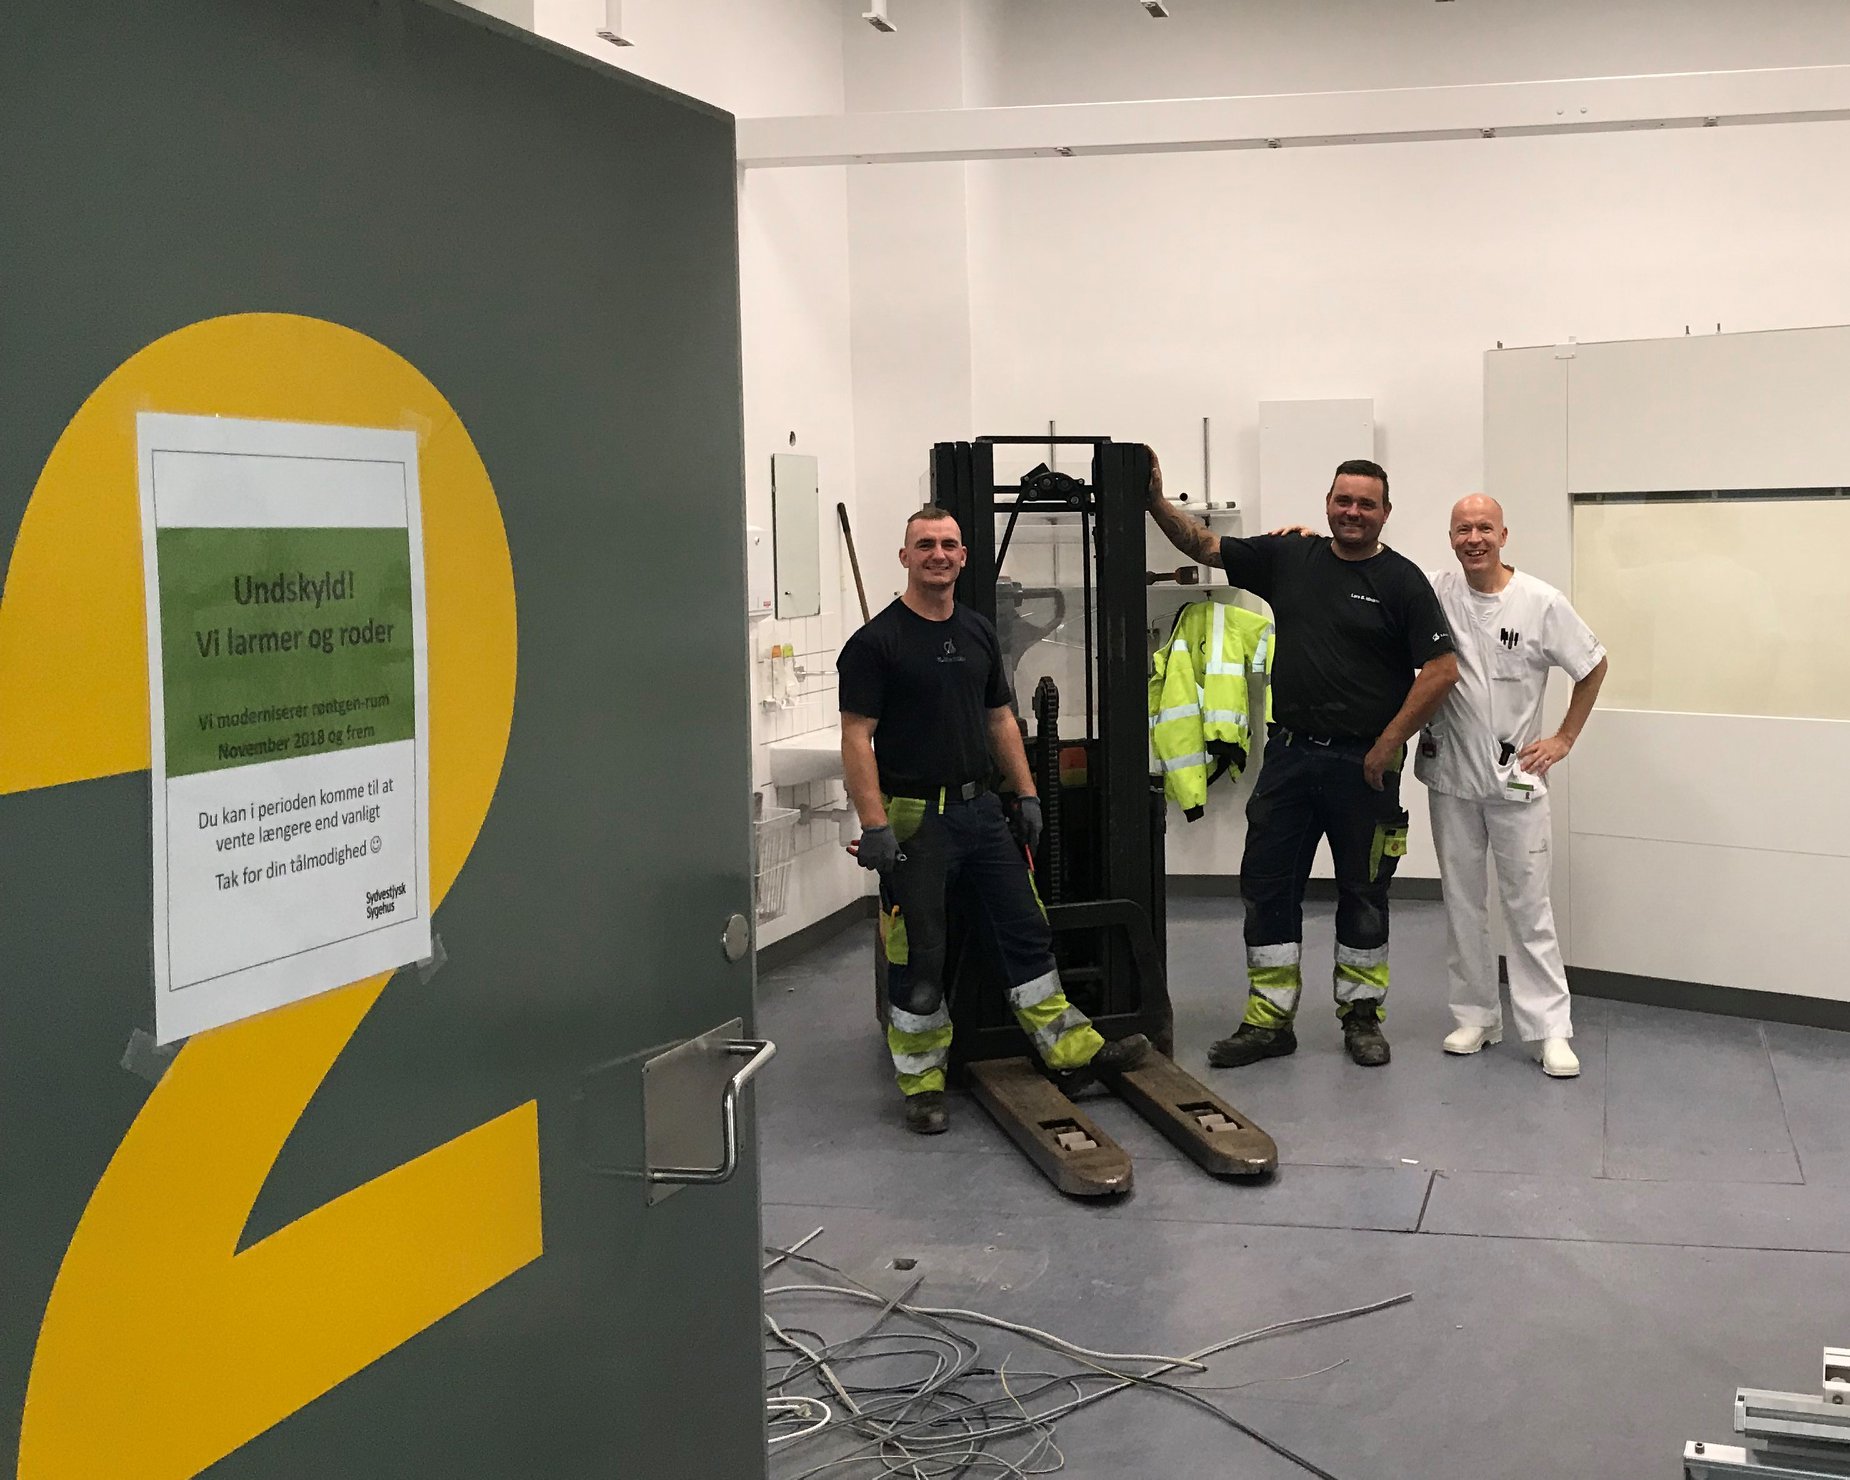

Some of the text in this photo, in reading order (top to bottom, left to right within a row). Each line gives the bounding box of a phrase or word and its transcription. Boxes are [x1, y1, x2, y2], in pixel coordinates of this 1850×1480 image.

[234, 570, 354, 609] Undskyld!
[196, 617, 395, 658] Vi larmer og roder
[199, 693, 390, 731] Vi moderniserer røntgen-rum
[218, 725, 375, 760] November 2018 og frem
[198, 778, 394, 830] Du kan i perioden komme til at
[216, 804, 380, 852] vente længere end vanligt
[215, 840, 367, 891] Tak for din tålmodighed
[0, 312, 543, 1480] 2
[366, 882, 406, 905] Sydvestjysk
[366, 901, 395, 920] Sygehus
